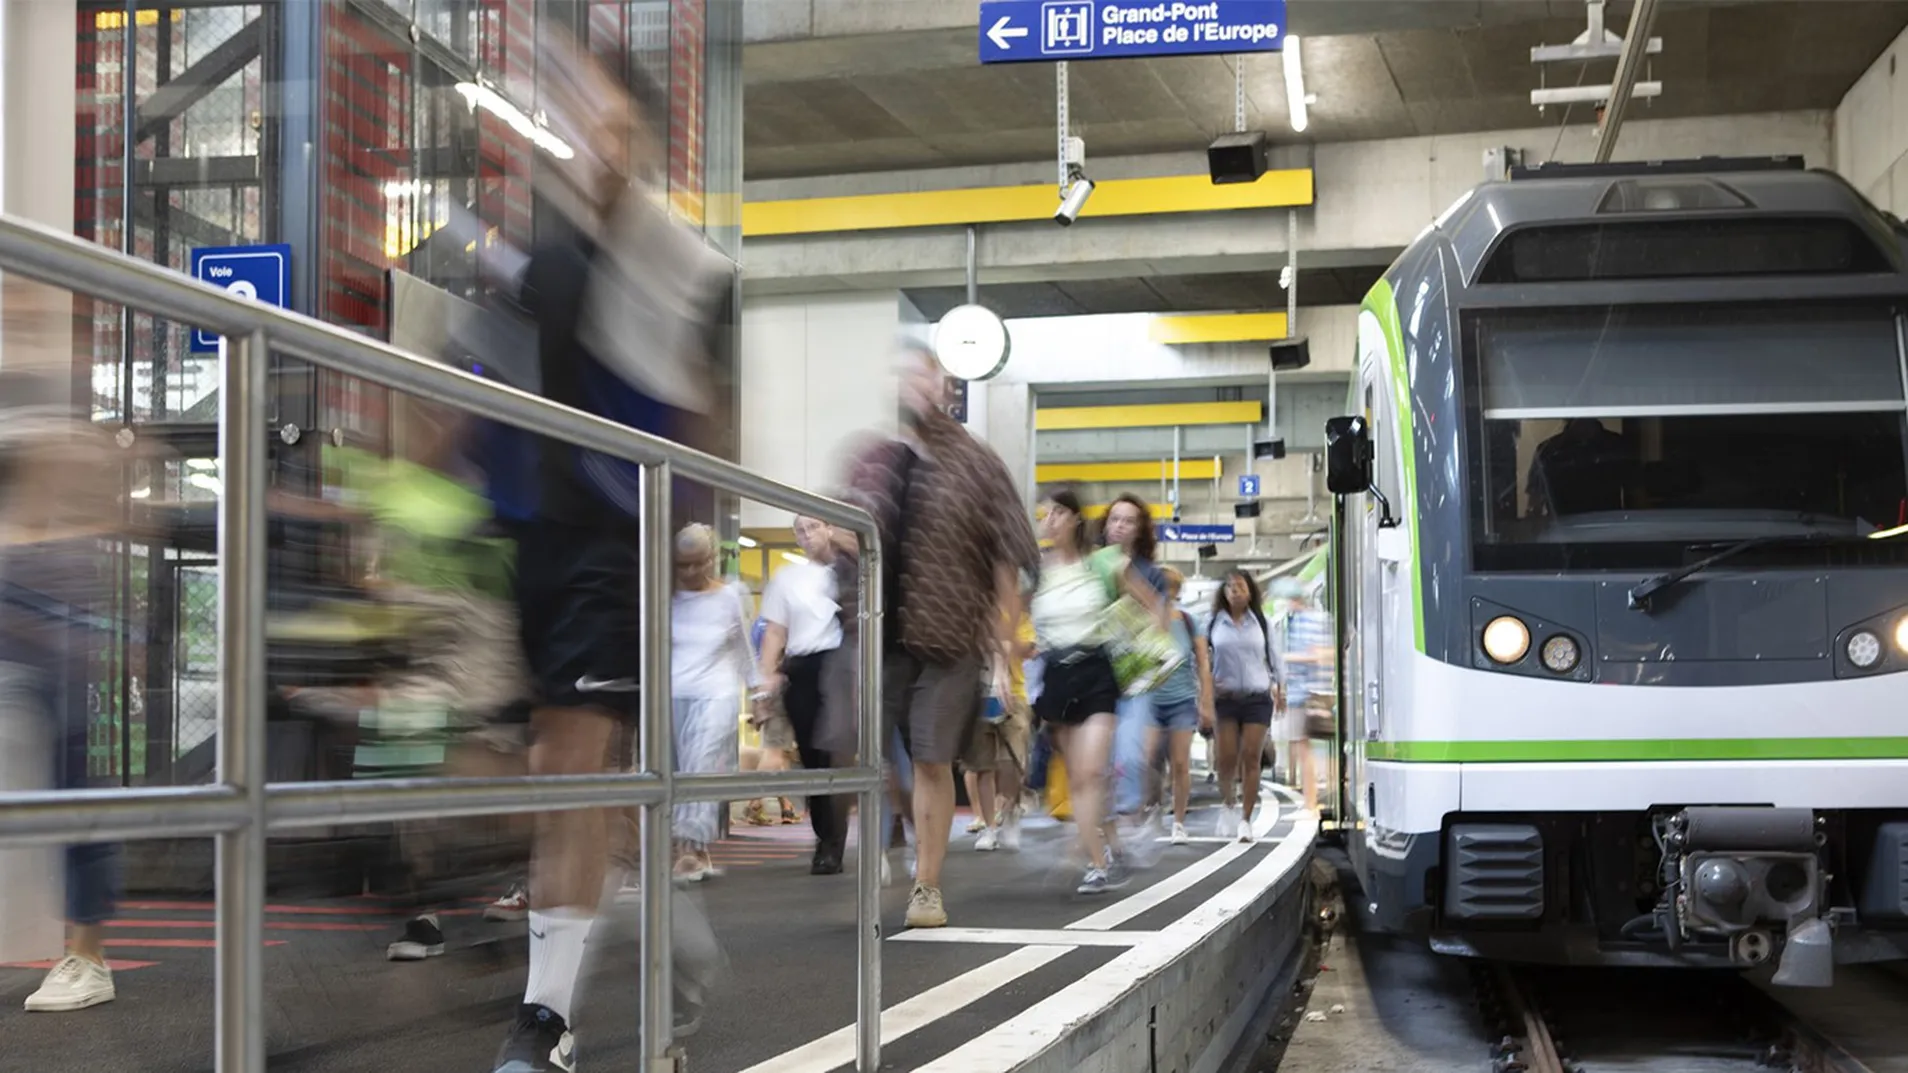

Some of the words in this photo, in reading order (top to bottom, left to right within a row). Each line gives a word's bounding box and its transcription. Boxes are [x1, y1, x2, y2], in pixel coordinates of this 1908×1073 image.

[1102, 2, 1218, 24] Grand-Pont
[1103, 26, 1158, 45] Place
[1163, 25, 1188, 42] de
[1194, 23, 1279, 43] l'Europe
[209, 267, 233, 278] Voie
[1245, 481, 1254, 493] 2
